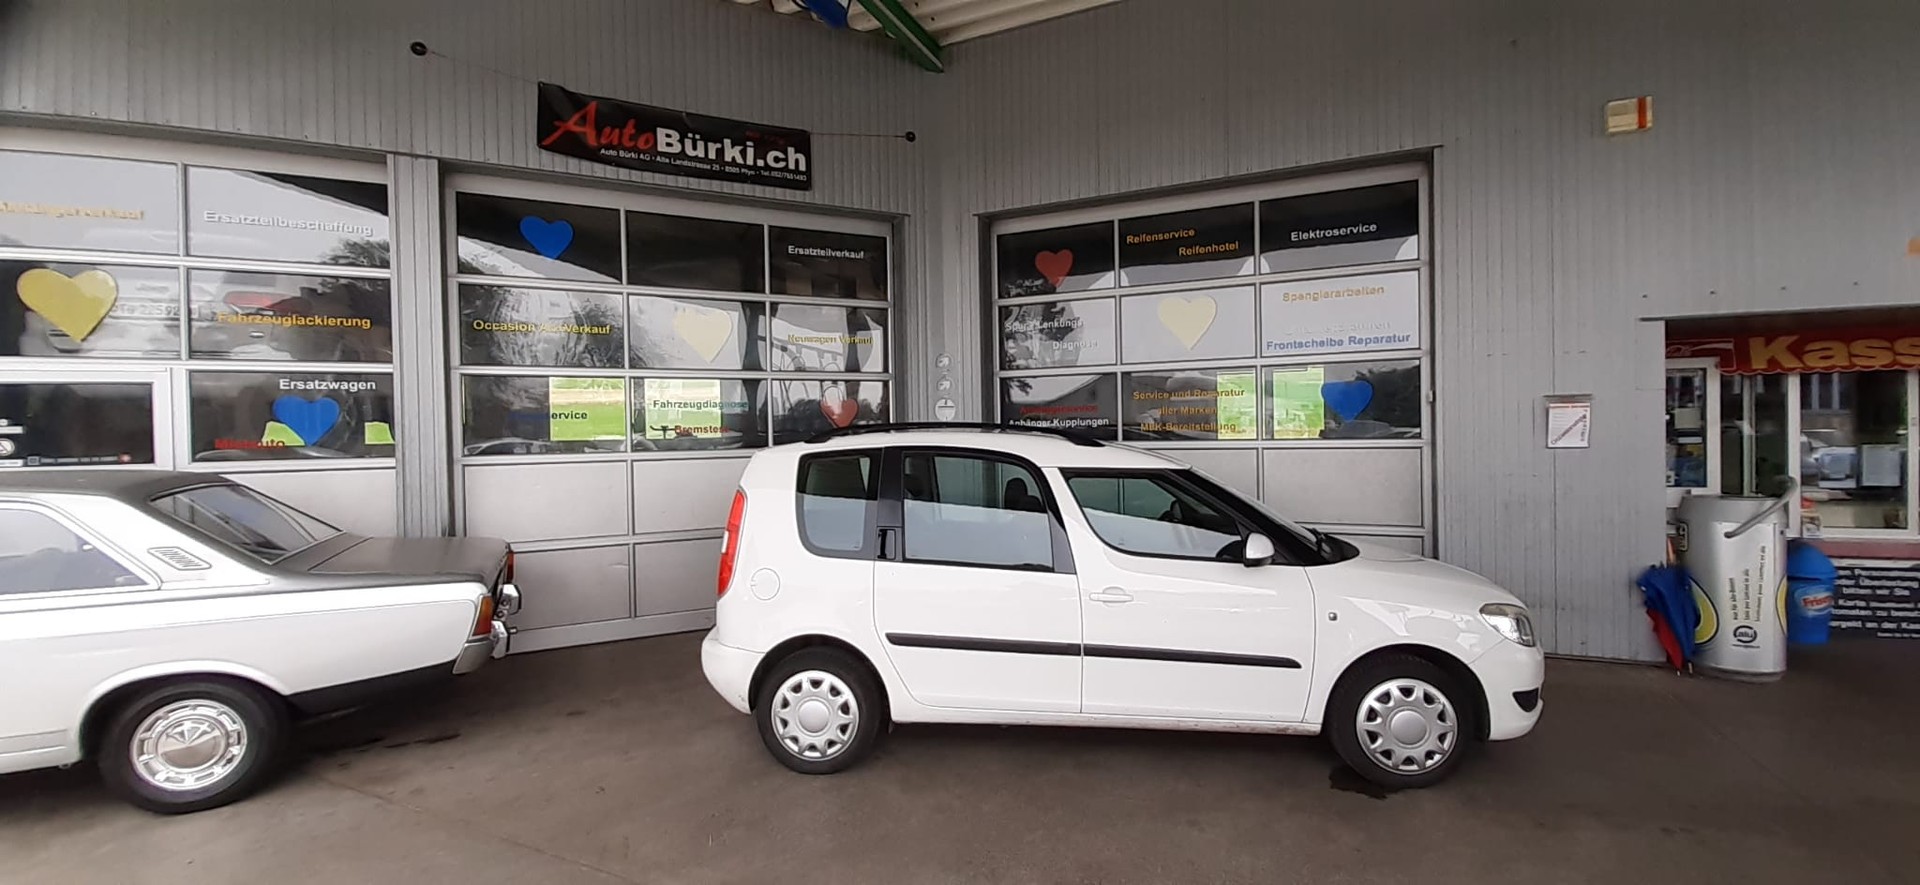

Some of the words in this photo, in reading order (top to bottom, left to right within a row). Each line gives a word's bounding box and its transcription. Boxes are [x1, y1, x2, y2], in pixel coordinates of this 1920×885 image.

[203, 210, 374, 236] Ersatzteilbeschaffung
[1126, 228, 1195, 245] Reifenservice
[1290, 222, 1377, 242] Elektroservice
[788, 244, 865, 260] Ersatzteilverkauf
[1178, 241, 1239, 257] Reifenhotel
[216, 312, 372, 330] Fahrzeuglackierung
[473, 320, 536, 332] Occasion
[1266, 337, 1344, 351] Frontscheibe
[1348, 333, 1411, 347] Reparatur
[279, 379, 376, 392] Ersatzwagen
[1133, 390, 1169, 401] Service
[653, 400, 749, 411] Fahrzeugdiagnose
[1053, 418, 1109, 428] Kupplungen
